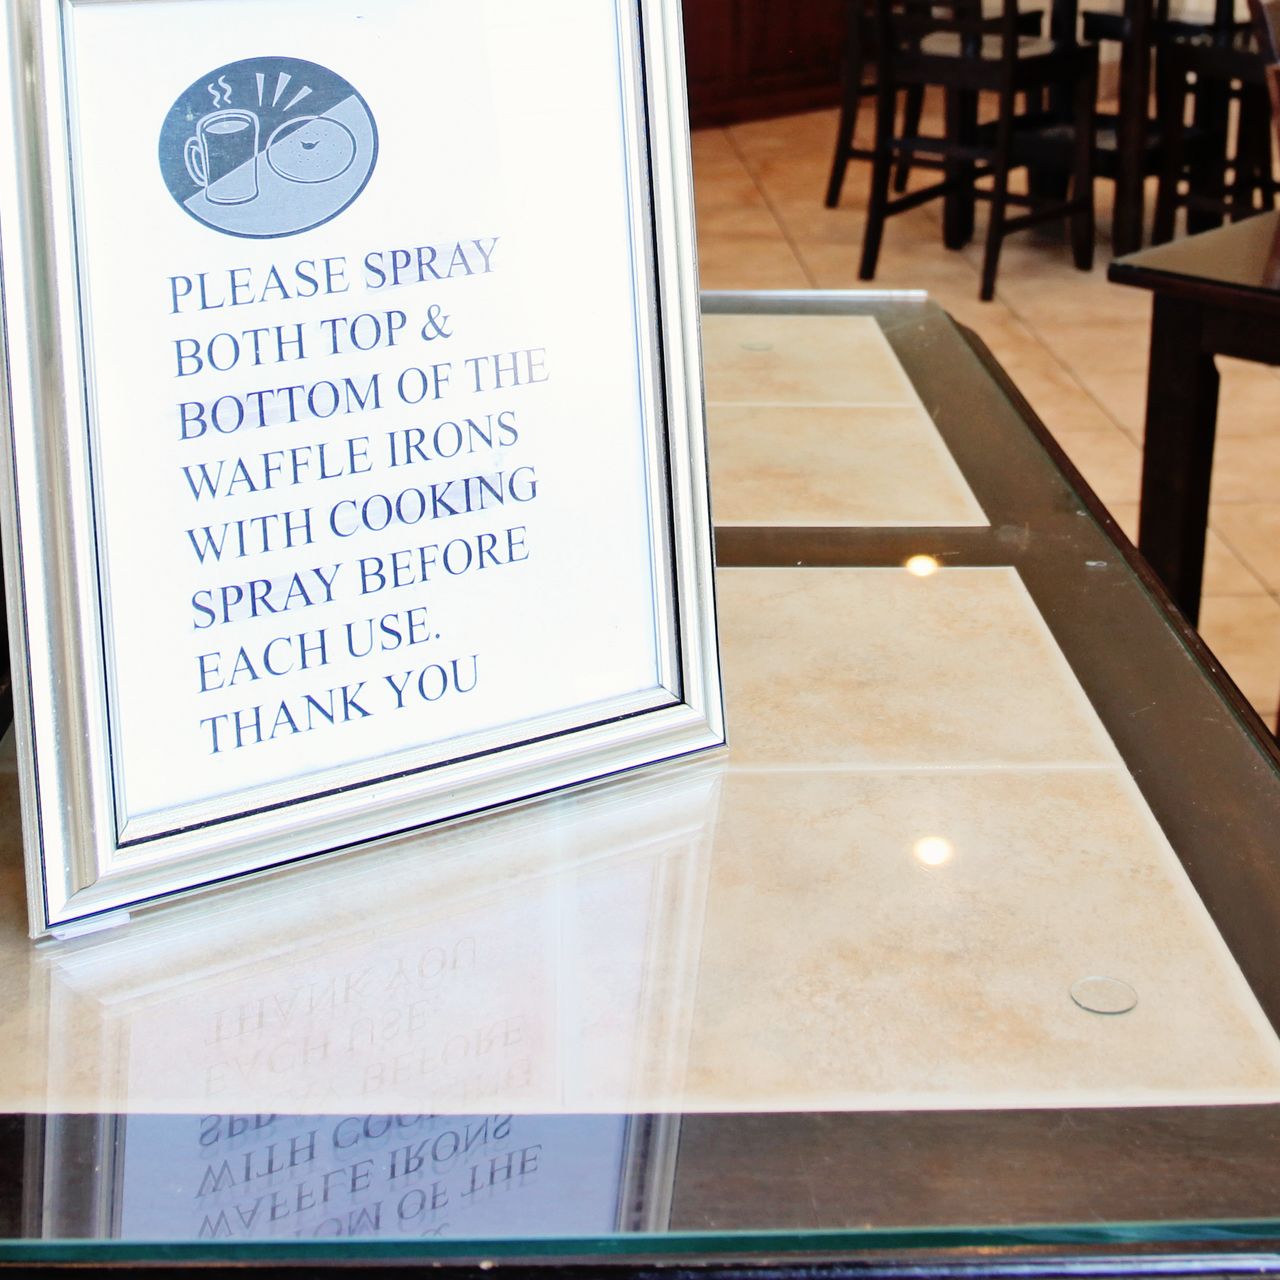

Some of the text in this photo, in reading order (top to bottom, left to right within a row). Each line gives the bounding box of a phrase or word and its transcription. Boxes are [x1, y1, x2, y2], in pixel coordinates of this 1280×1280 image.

[167, 236, 500, 315] PLEASE SPRAY
[172, 303, 454, 378] BOTH TOP &
[175, 348, 551, 441] BOTTOM OF THE
[181, 410, 519, 503] WAFFLE IRONS
[183, 466, 539, 565] WITH COOKING
[191, 525, 531, 631] SPRAY BEFORE
[195, 606, 442, 694] EACH USE.
[199, 653, 480, 755] THANK YOU
